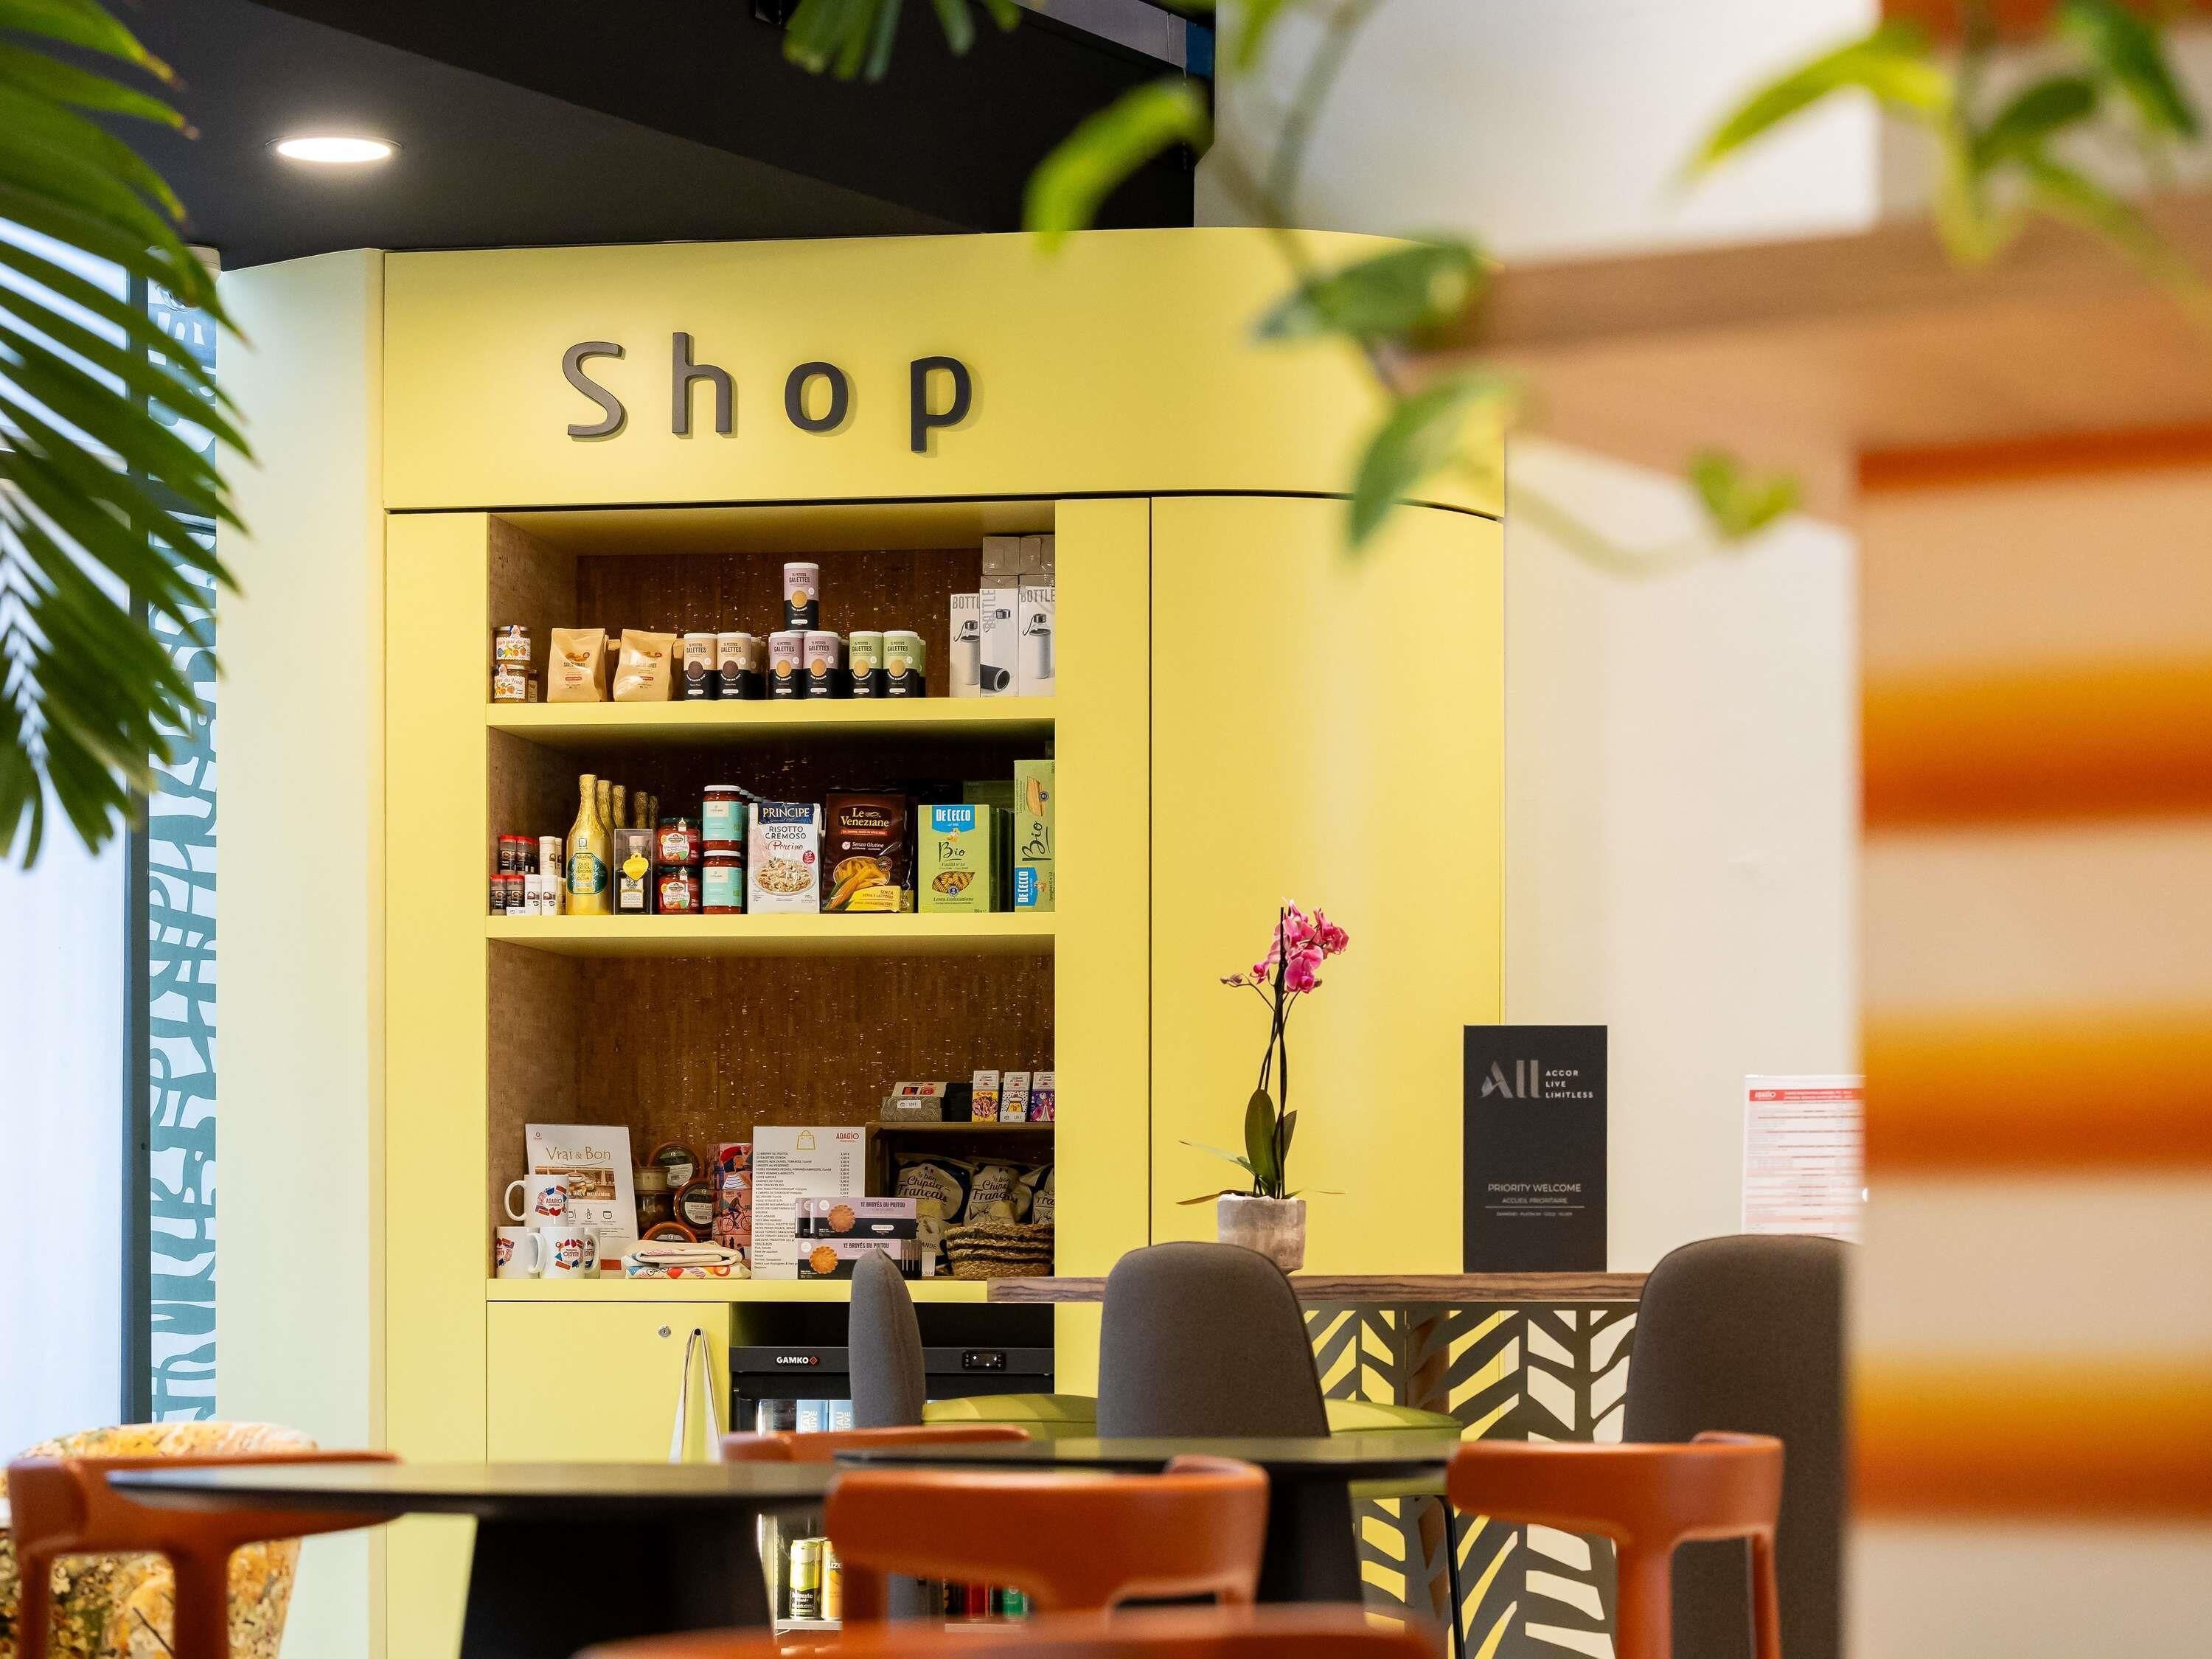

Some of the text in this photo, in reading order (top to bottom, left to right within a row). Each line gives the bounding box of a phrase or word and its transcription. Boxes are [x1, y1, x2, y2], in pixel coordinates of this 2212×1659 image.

[562, 332, 973, 453] Shop
[1020, 589, 1055, 602] BOTTLE
[952, 596, 979, 609] BOTTL
[762, 807, 810, 818] PRINCIPE
[852, 807, 864, 818] Le
[936, 809, 971, 821] DE CECCO
[841, 815, 889, 827] Veneziane
[1022, 821, 1052, 861] Bio
[939, 841, 966, 862] Bio
[1018, 871, 1029, 902] DE CECCO
[835, 1131, 860, 1140] ADAGIO
[546, 1145, 572, 1161] Vrai
[585, 1146, 611, 1160] Bon
[908, 1175, 945, 1190] Chipster
[981, 1179, 1009, 1191] Chips
[1488, 1183, 1582, 1192] PRIORITY WELCOME
[896, 1183, 949, 1203] Français
[922, 1242, 936, 1250] ANDE
[776, 1356, 809, 1364] GAMKO
[802, 1411, 810, 1432] EAU
[836, 1411, 844, 1431] EAU
